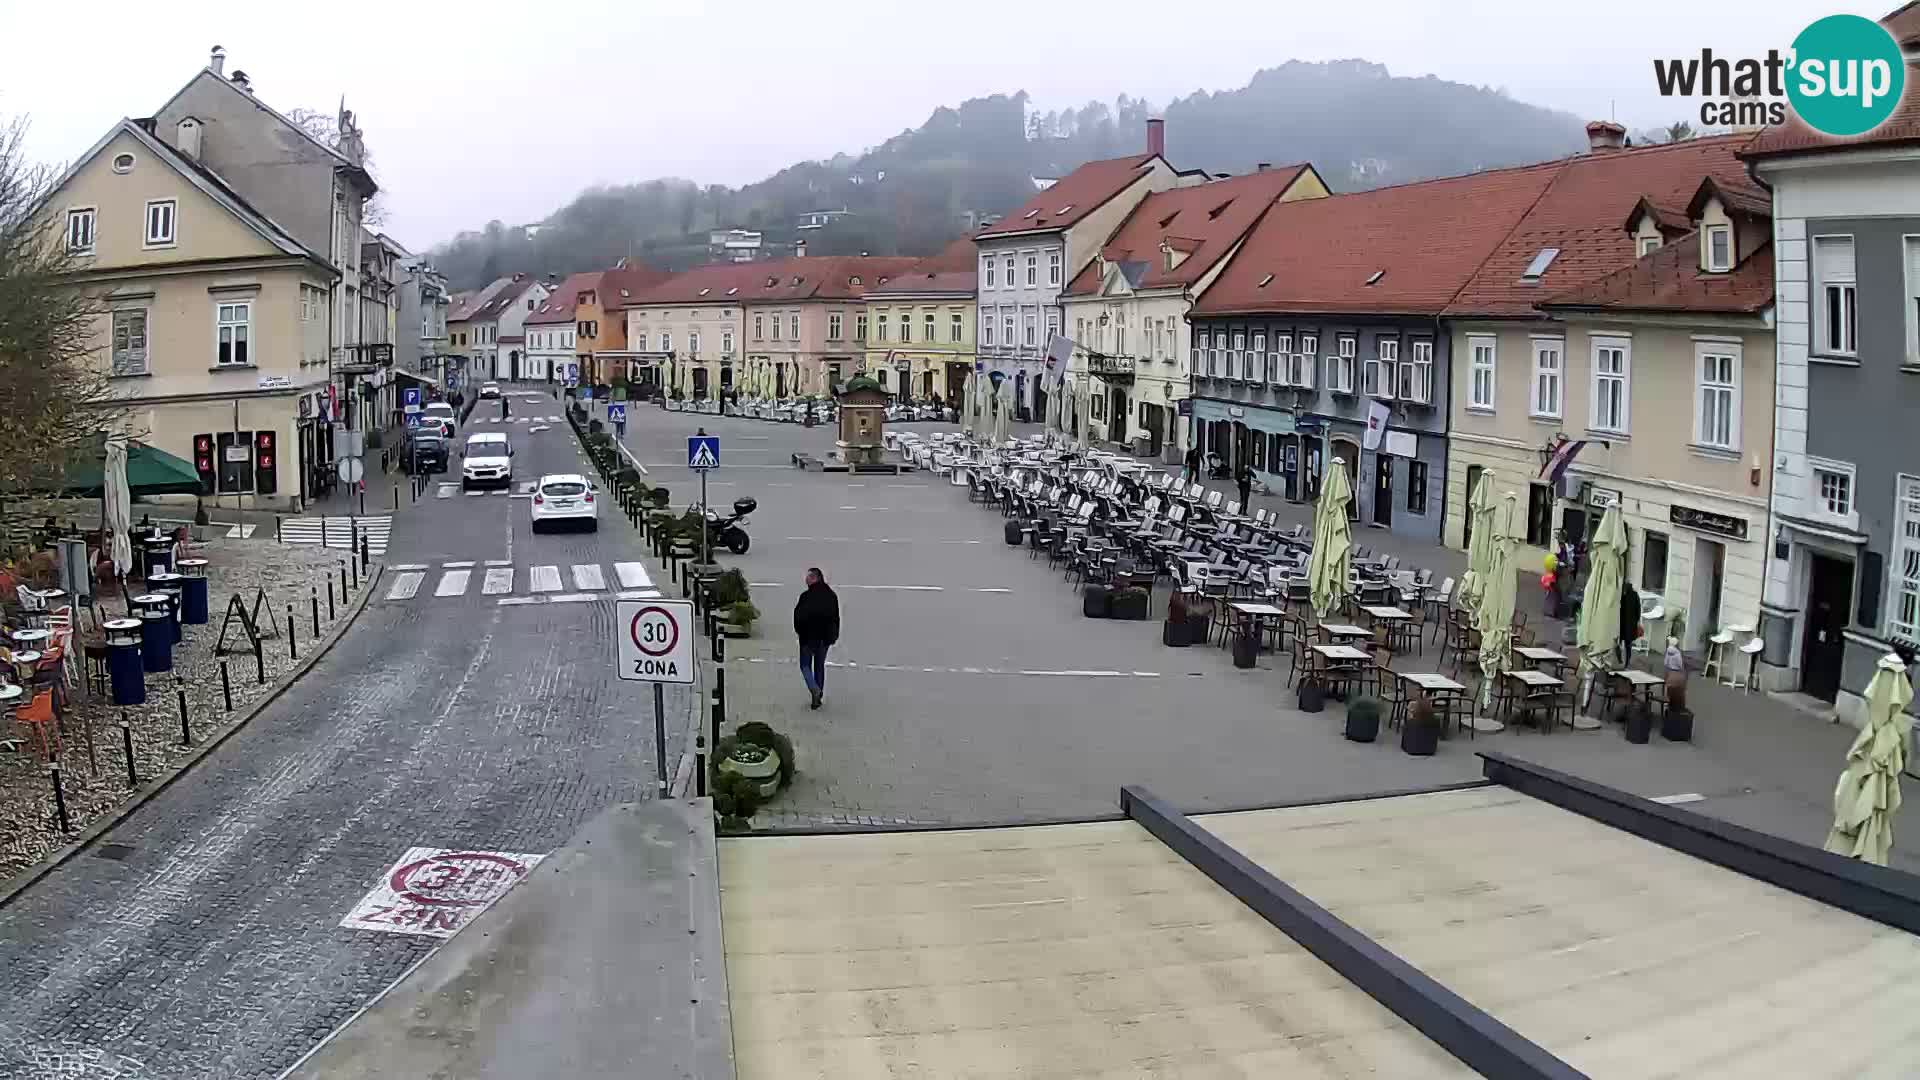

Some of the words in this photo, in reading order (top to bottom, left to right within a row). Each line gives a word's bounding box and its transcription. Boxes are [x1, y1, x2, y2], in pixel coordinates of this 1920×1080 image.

[408, 391, 416, 403] P
[643, 622, 667, 643] 30
[633, 659, 678, 677] ZONA
[358, 904, 465, 930] ZON
